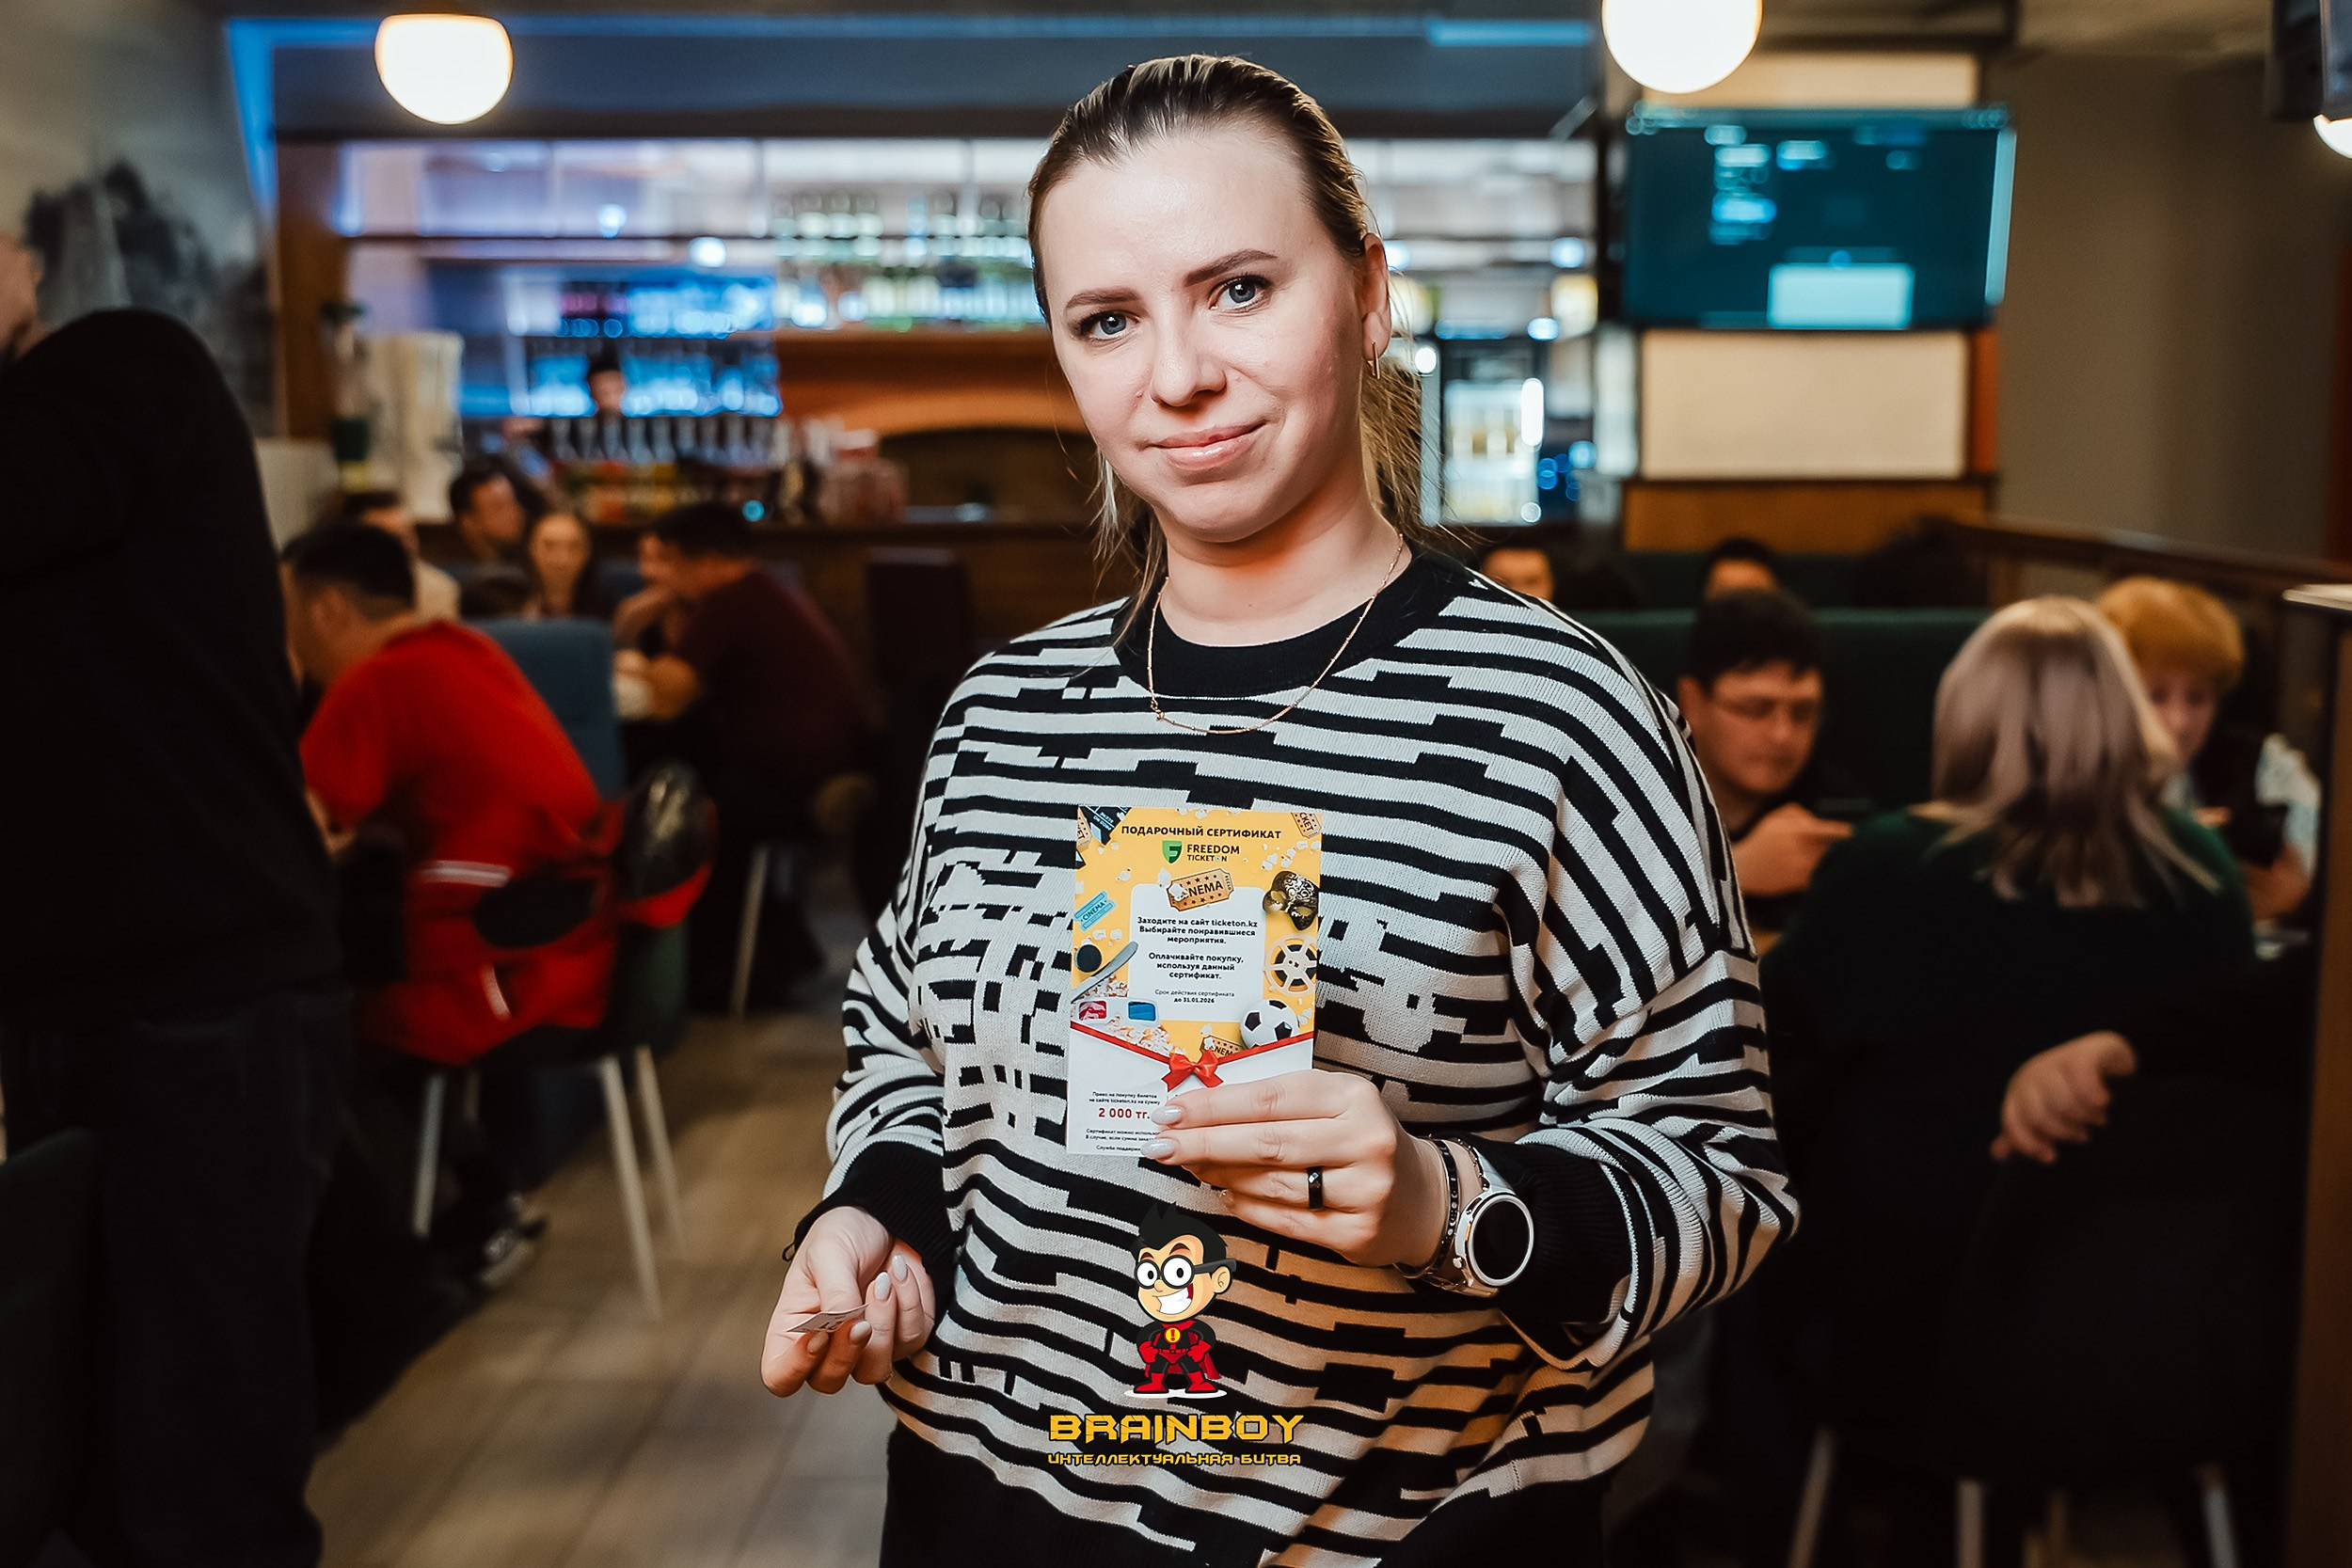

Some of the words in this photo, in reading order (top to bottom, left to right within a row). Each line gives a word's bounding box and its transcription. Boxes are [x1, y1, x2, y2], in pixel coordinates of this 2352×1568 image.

[1299, 812, 1314, 832] CKET
[1121, 825, 1204, 836] ПОДАРОЧНЫЙ
[1206, 828, 1282, 839] СЕРТИФИКАТ
[1186, 844, 1240, 854] FREEDOM
[1187, 880, 1224, 897] NEMA
[1082, 901, 1106, 921] CINEMA
[1137, 916, 1176, 926] Заходите
[1211, 919, 1259, 927] ticketon.kz
[1139, 926, 1186, 935] Выбирайте
[1148, 952, 1204, 960] Оплачивайте
[1206, 955, 1244, 964] покупку,
[1201, 963, 1235, 972] данный
[1099, 1107, 1105, 1117] 2
[1109, 1108, 1132, 1118] 000
[1136, 1111, 1151, 1119] тг.
